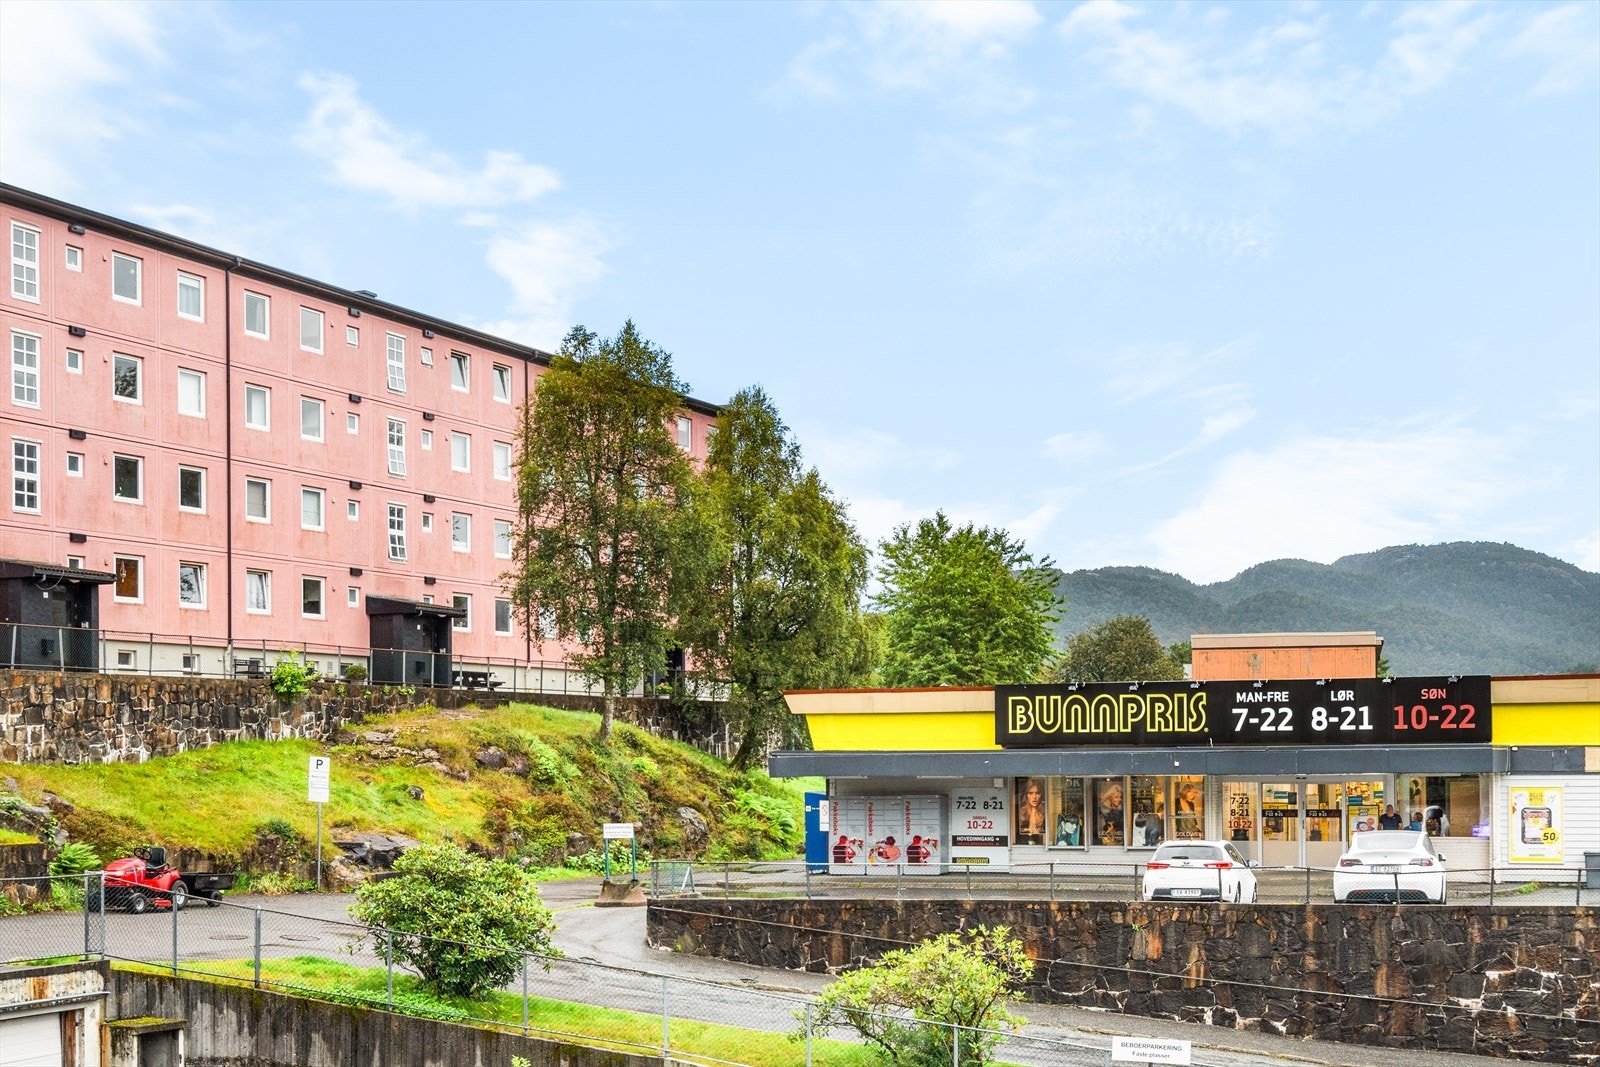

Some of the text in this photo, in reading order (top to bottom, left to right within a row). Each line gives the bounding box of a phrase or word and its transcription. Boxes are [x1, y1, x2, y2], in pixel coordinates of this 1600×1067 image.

[1236, 691, 1289, 702] MAN-FRE
[1331, 690, 1354, 701] LØR
[1421, 688, 1446, 699] SØN
[1008, 692, 1207, 733] BUNNPRIS
[1311, 706, 1373, 730] 8-21
[1393, 704, 1476, 729] 10-22
[1232, 708, 1293, 731] 7-22
[316, 759, 323, 769] P
[956, 801, 976, 809] 7-22
[983, 801, 1003, 809] 8-21
[967, 821, 993, 829] 10-22
[1121, 1041, 1182, 1051] BEBOERPARKERING
